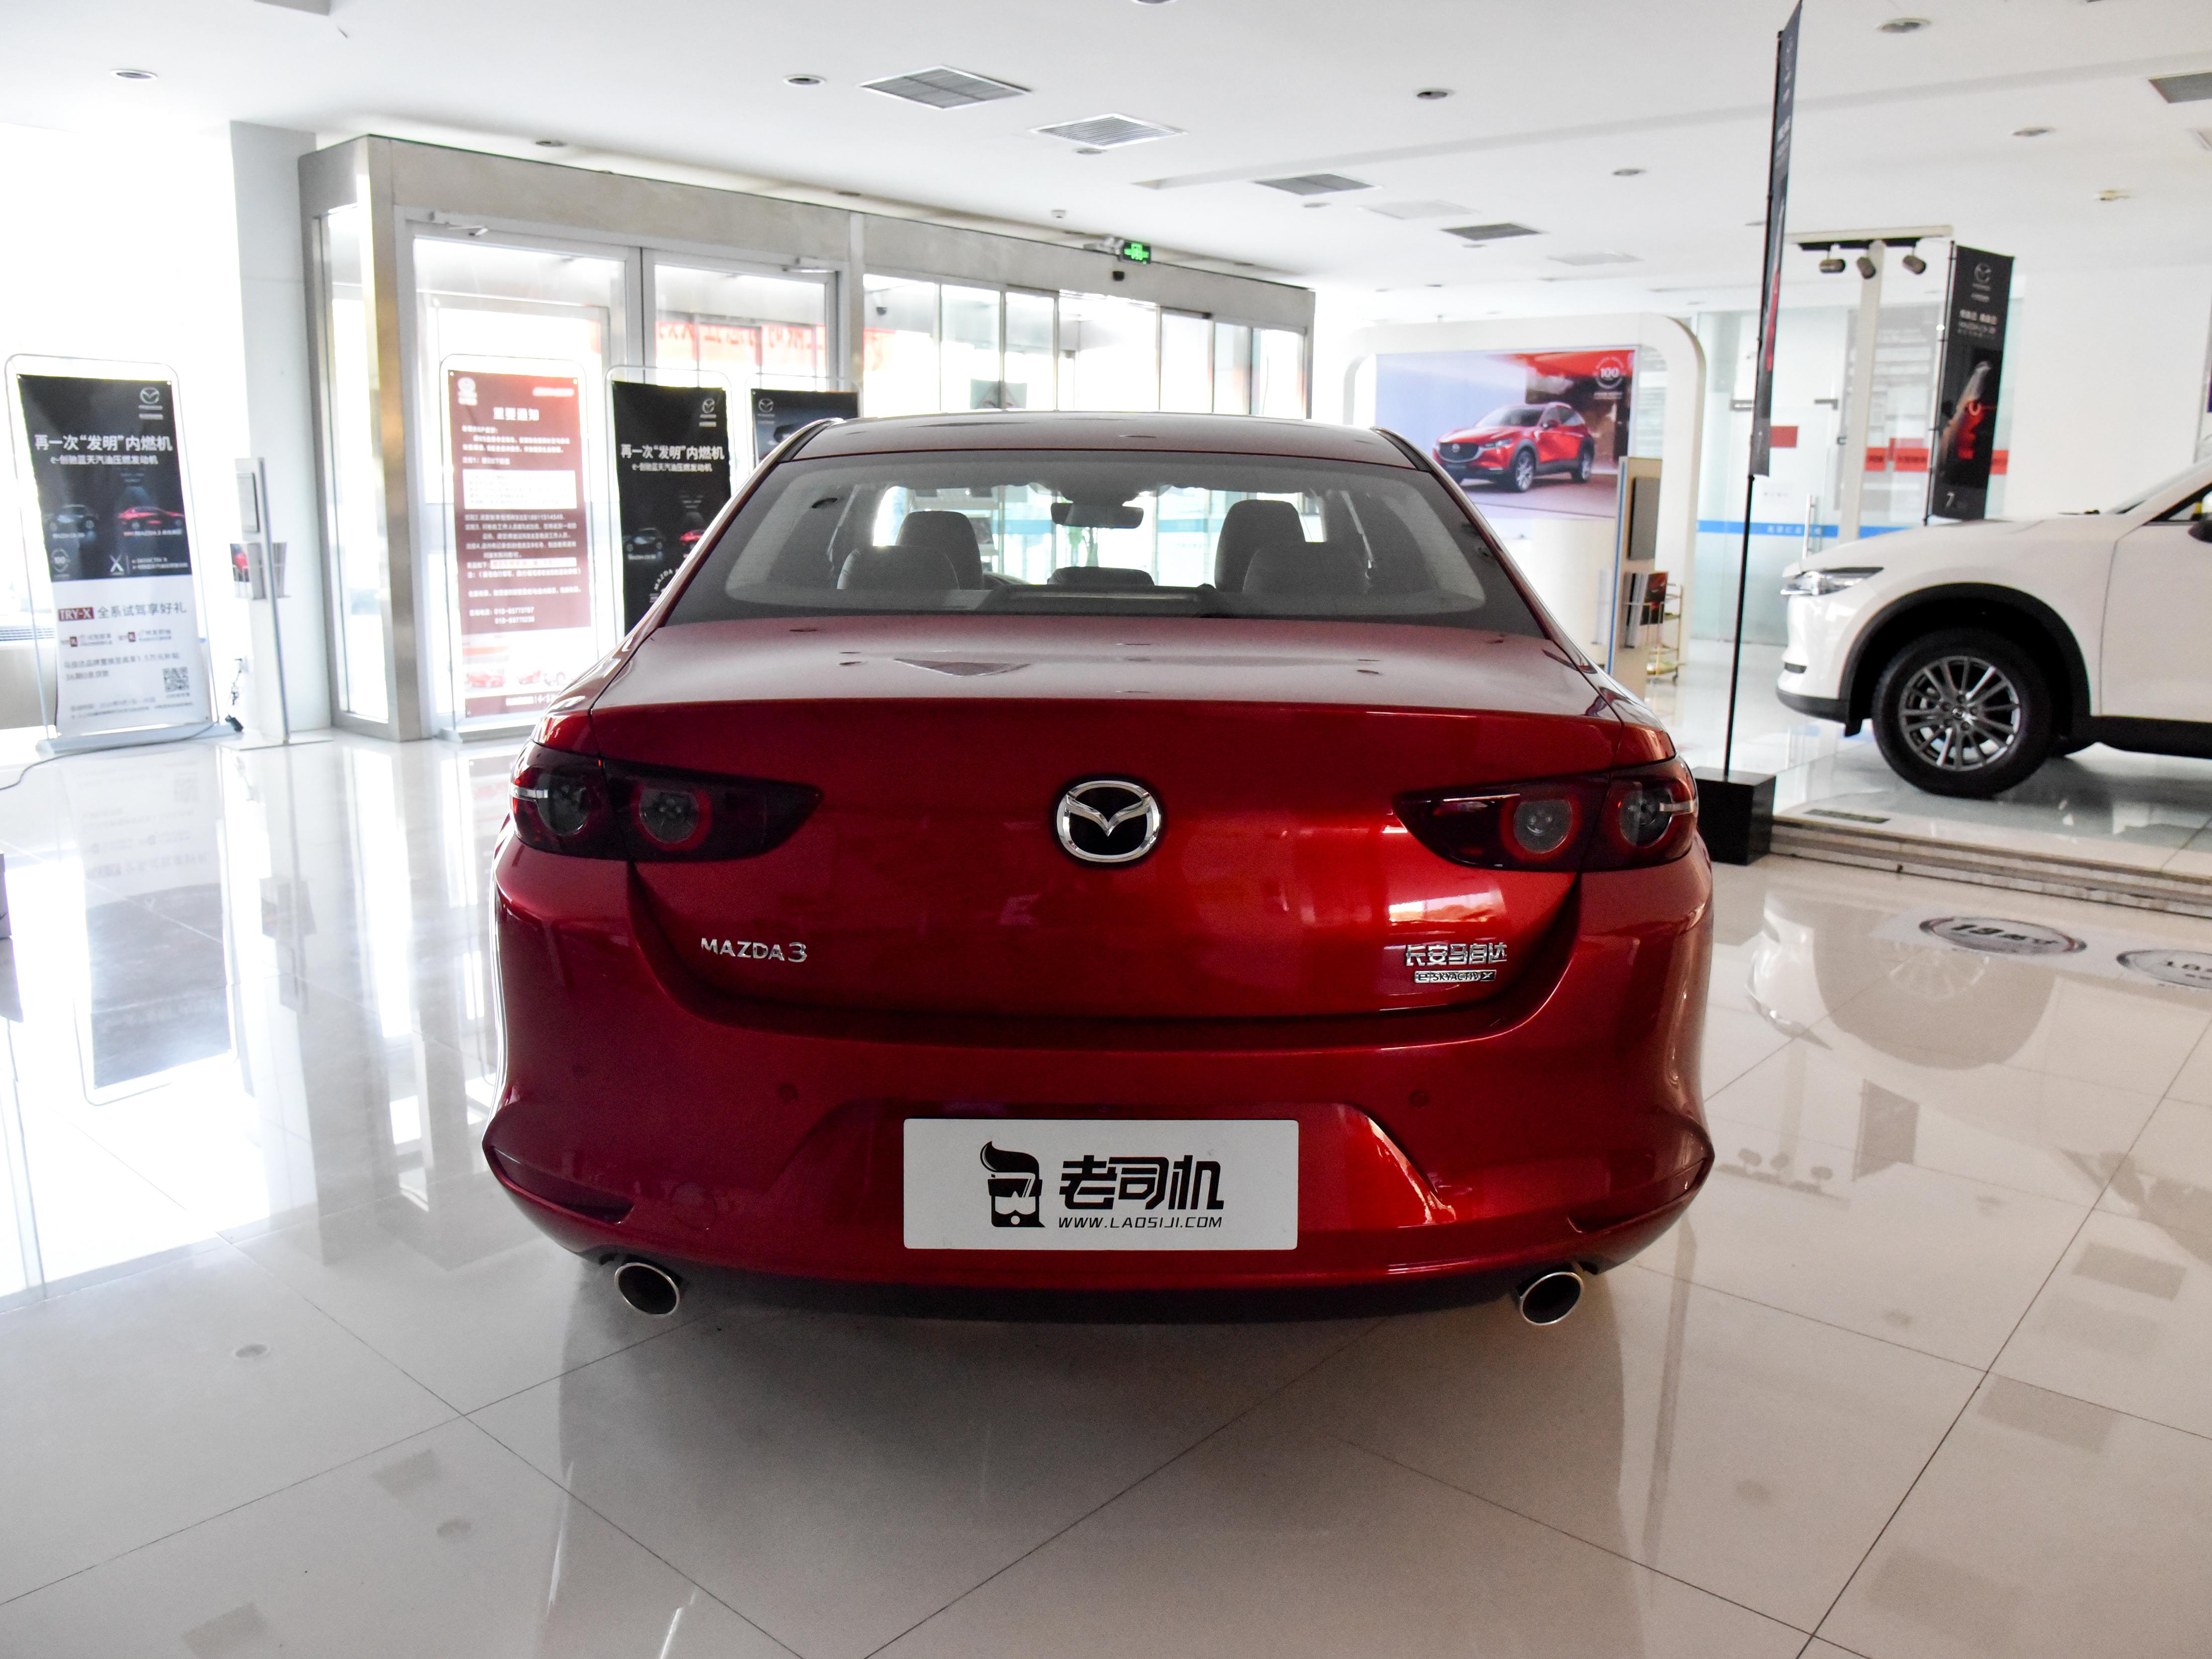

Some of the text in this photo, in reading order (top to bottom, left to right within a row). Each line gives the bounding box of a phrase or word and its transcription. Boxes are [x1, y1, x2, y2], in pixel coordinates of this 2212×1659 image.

[1405, 942, 1507, 966] 长安马自达
[1059, 1155, 1224, 1210] 老司机
[1058, 1217, 1222, 1228] WWW.LAOSIJI.COM
